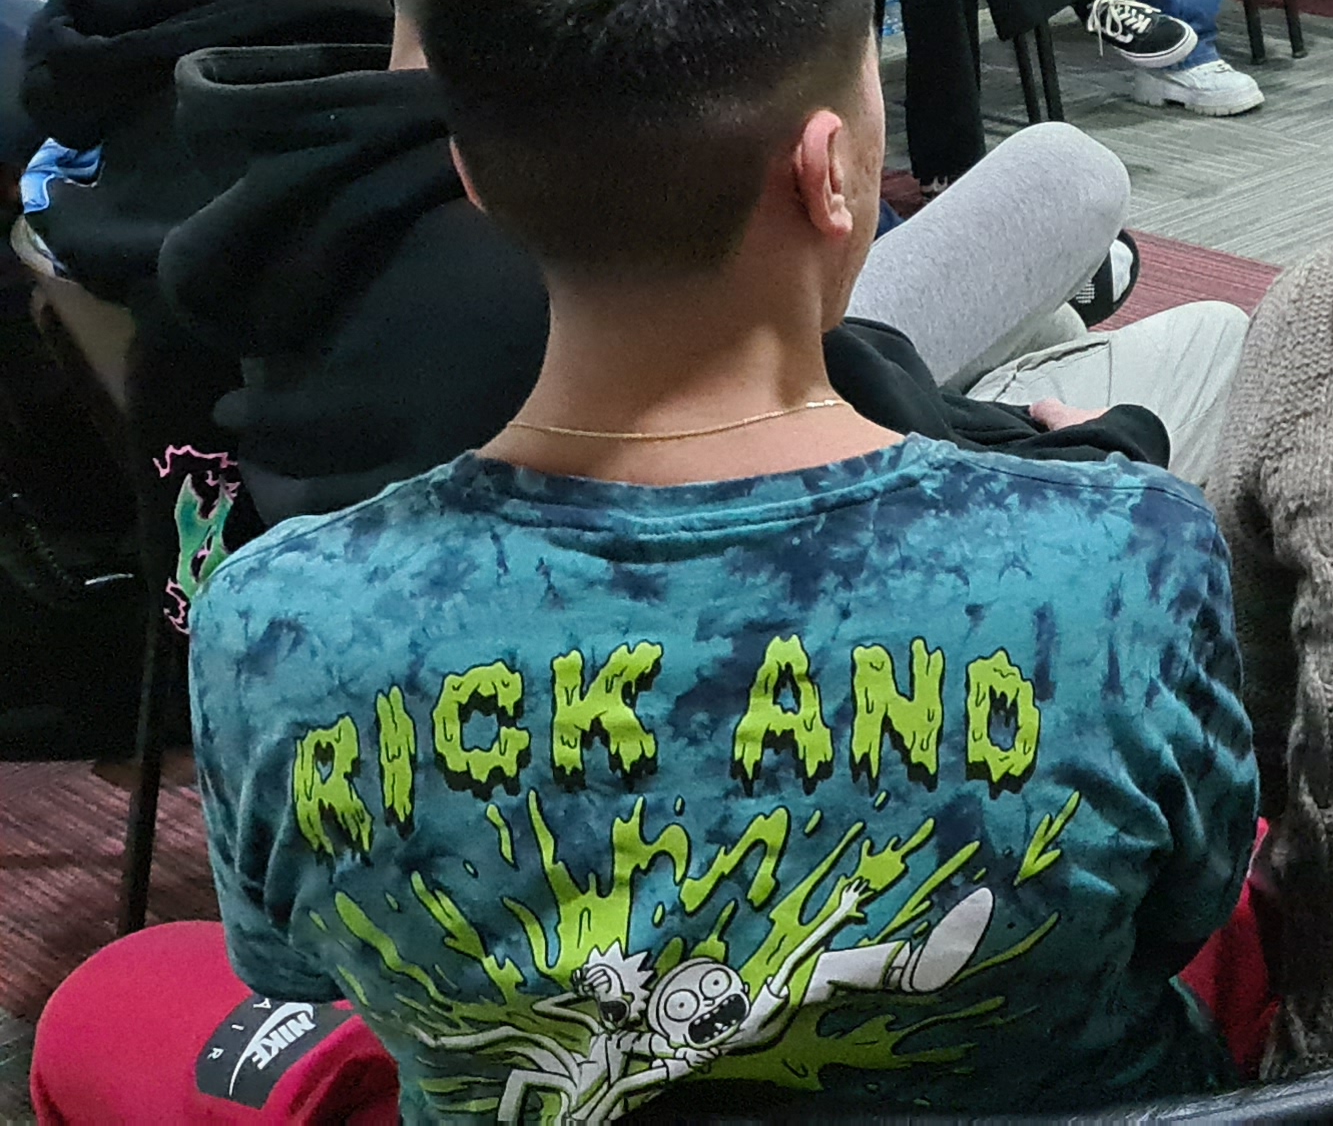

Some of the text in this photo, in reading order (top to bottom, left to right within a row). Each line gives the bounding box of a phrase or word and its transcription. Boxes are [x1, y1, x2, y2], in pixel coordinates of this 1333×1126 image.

[292, 634, 1041, 858] RICK AND
[252, 1012, 317, 1071] NIKE
